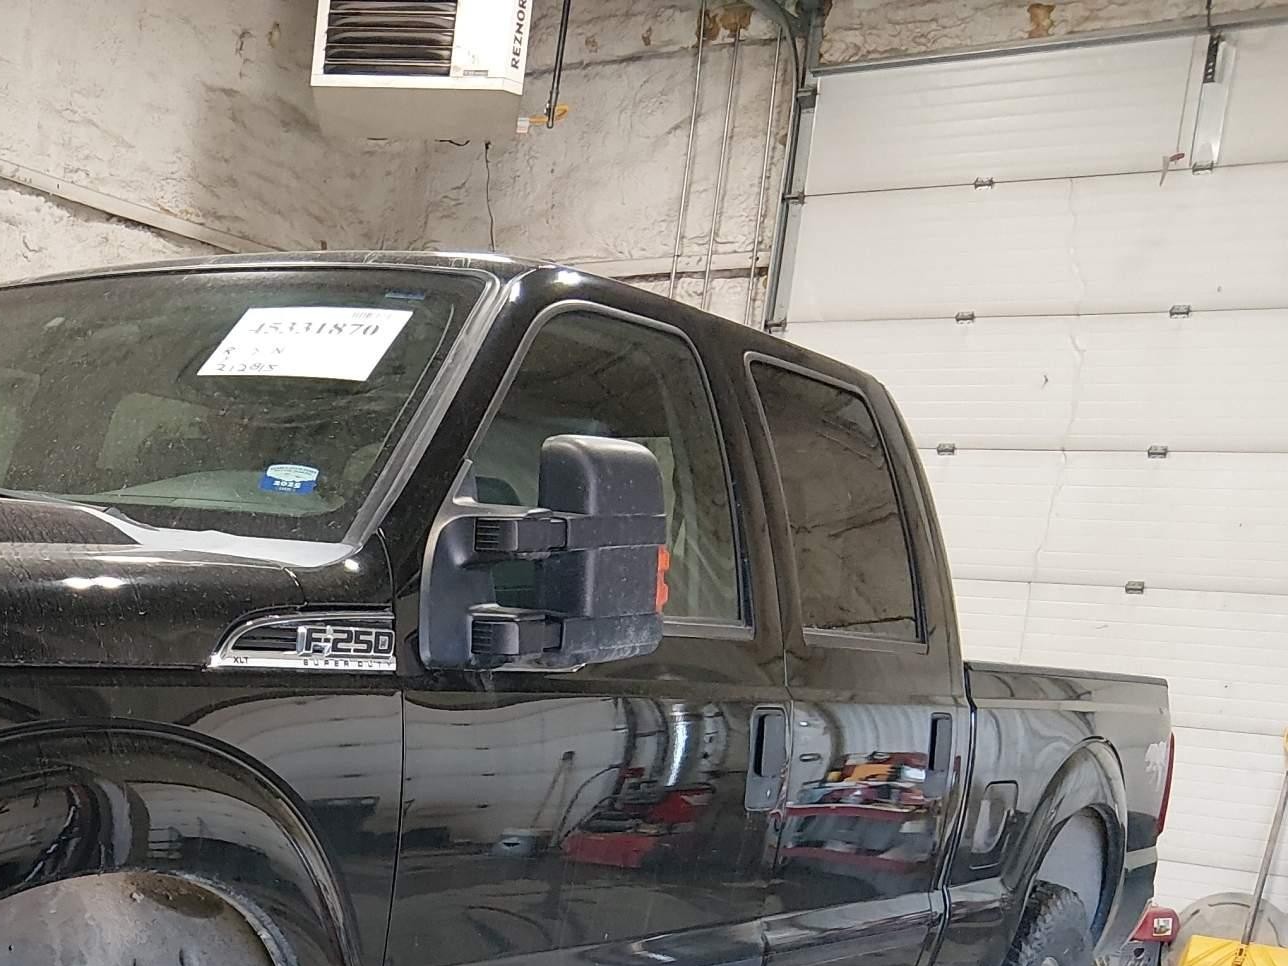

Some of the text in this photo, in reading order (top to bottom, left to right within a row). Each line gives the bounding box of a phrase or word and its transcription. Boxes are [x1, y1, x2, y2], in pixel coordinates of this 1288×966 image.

[510, 0, 528, 70] REZNOR
[248, 321, 381, 337] 45331870
[304, 627, 394, 655] F-250
[232, 656, 249, 665] XLT
[303, 658, 394, 668] SUPER DUTY
